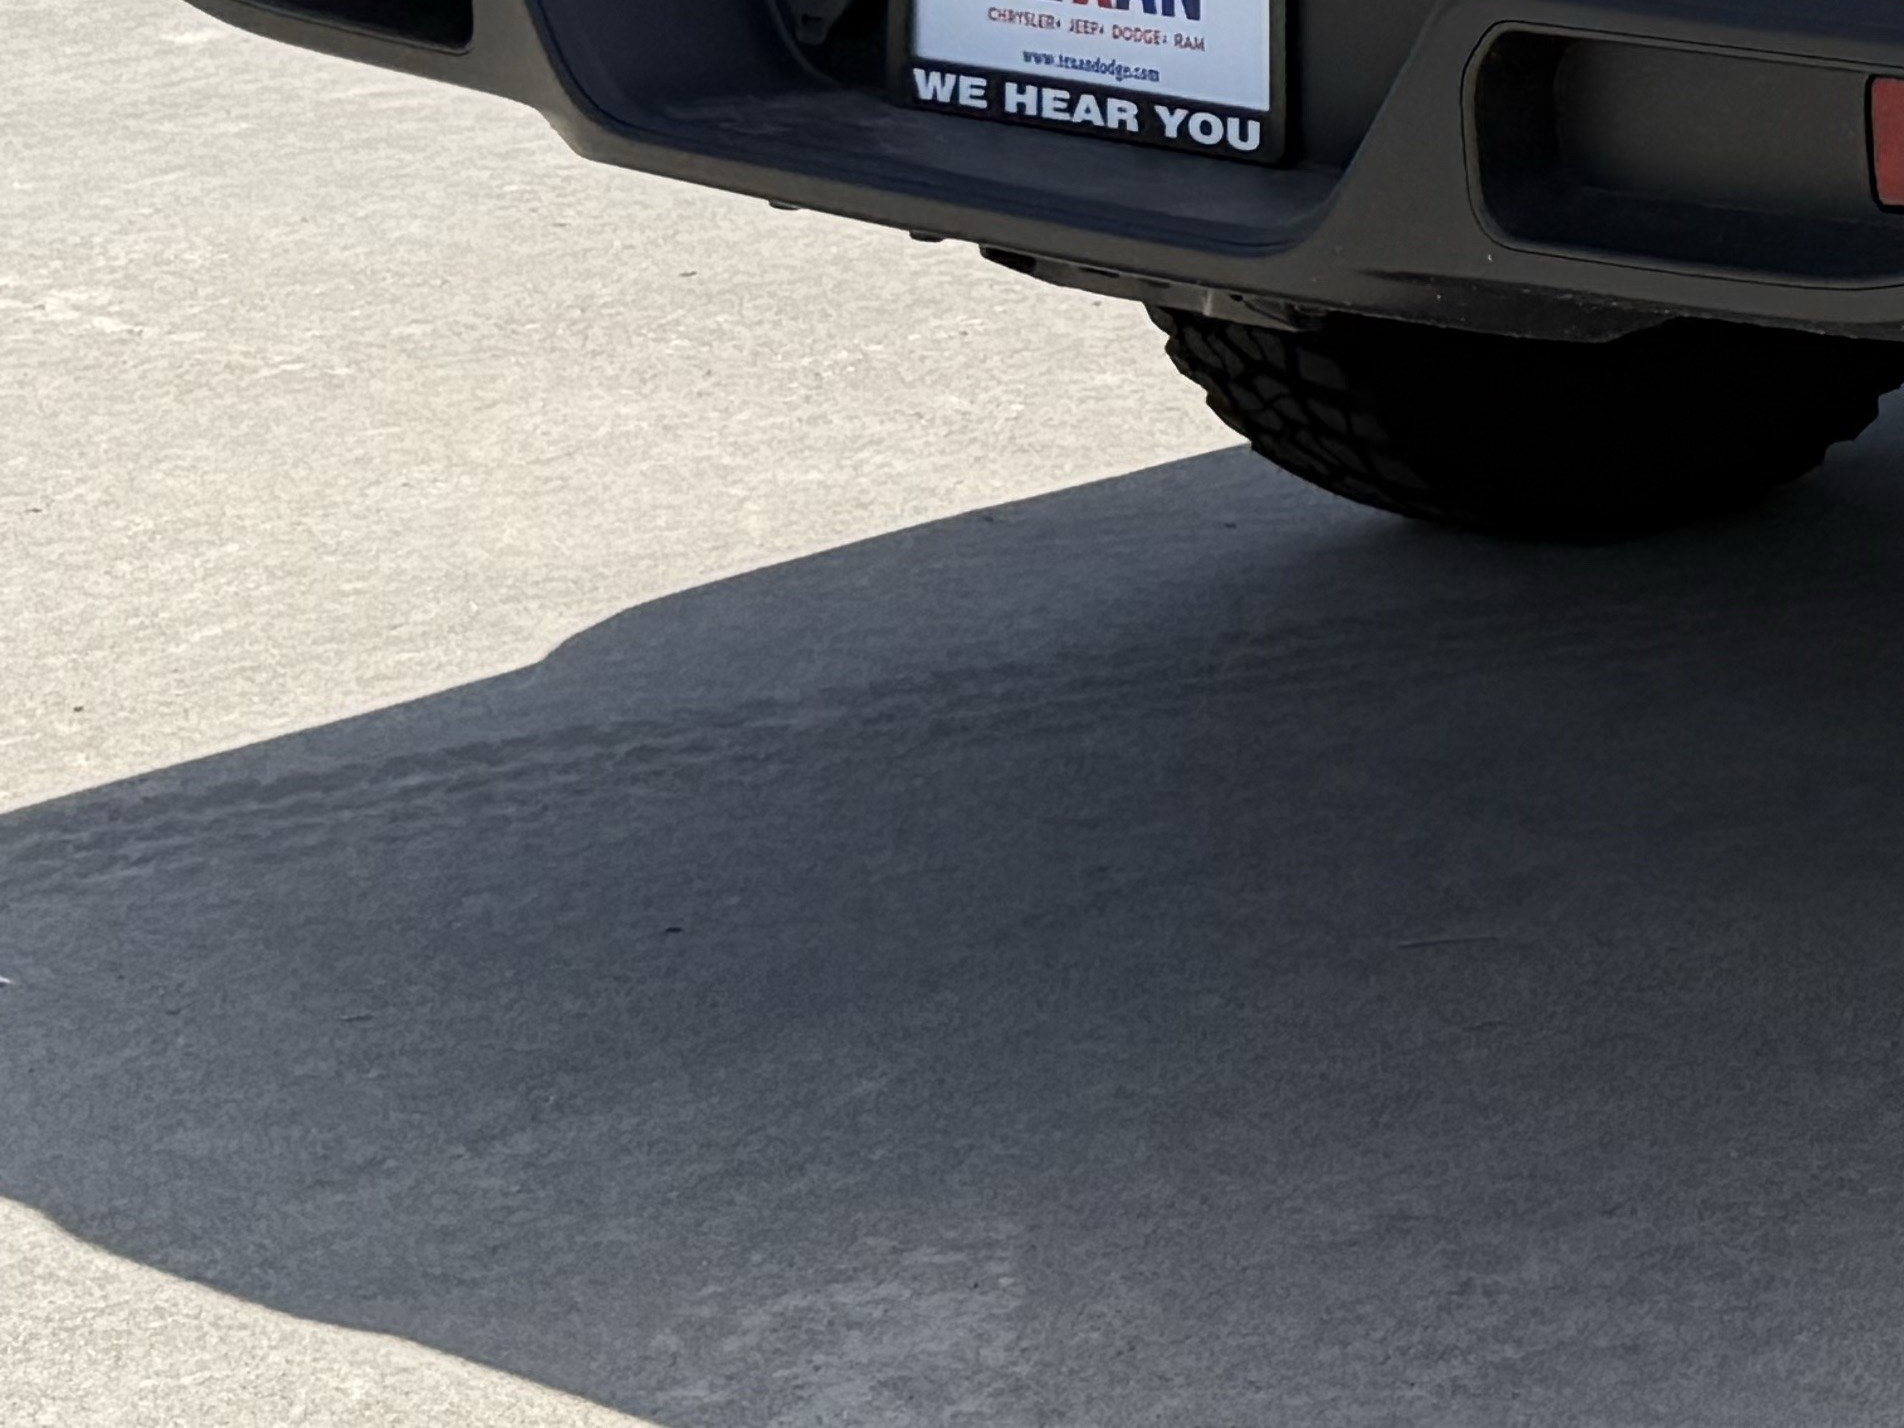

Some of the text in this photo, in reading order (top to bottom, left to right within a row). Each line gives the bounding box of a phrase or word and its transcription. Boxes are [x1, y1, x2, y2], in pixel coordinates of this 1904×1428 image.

[987, 6, 1206, 52] CHRYSLER JEEP DODGE RAM
[913, 68, 1262, 152] WE HEAR YOU
